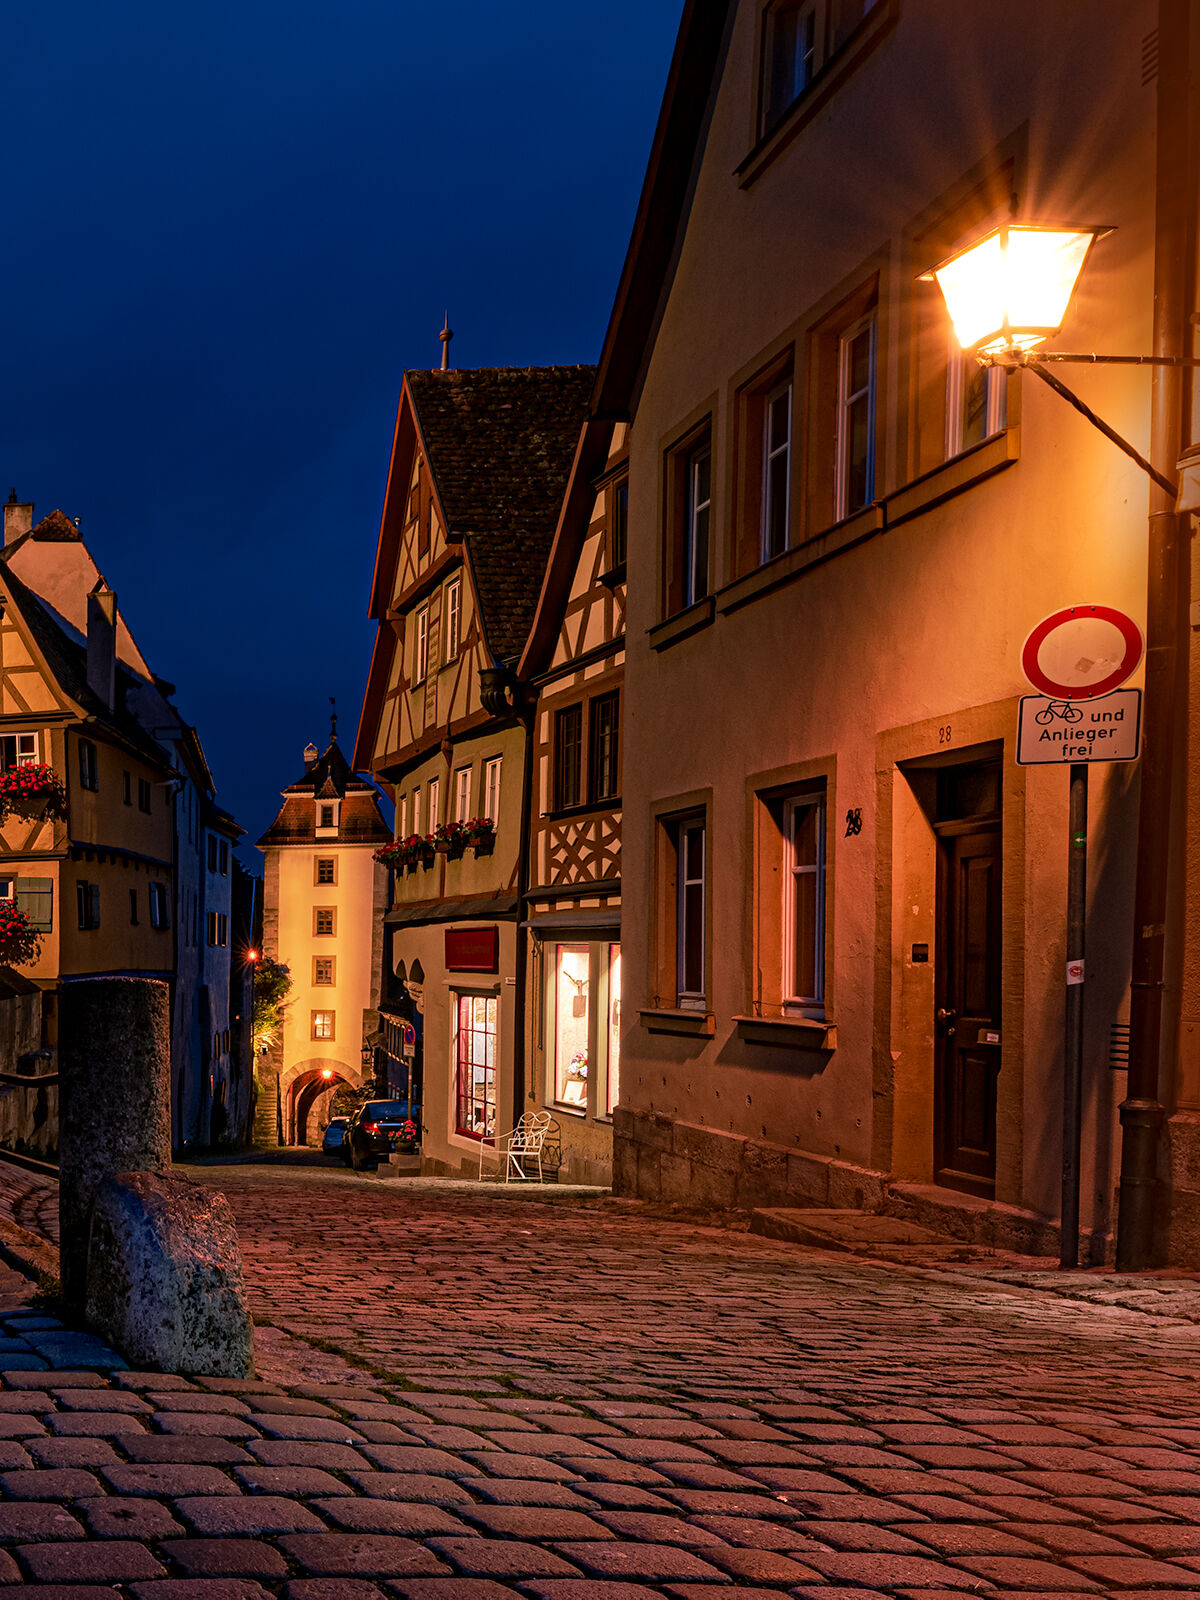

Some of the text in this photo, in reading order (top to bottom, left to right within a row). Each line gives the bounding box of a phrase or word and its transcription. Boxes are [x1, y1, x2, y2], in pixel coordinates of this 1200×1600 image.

[1091, 708, 1125, 722] und
[938, 725, 952, 744] 28
[1039, 727, 1118, 742] Anlieger
[1062, 742, 1093, 757] frei
